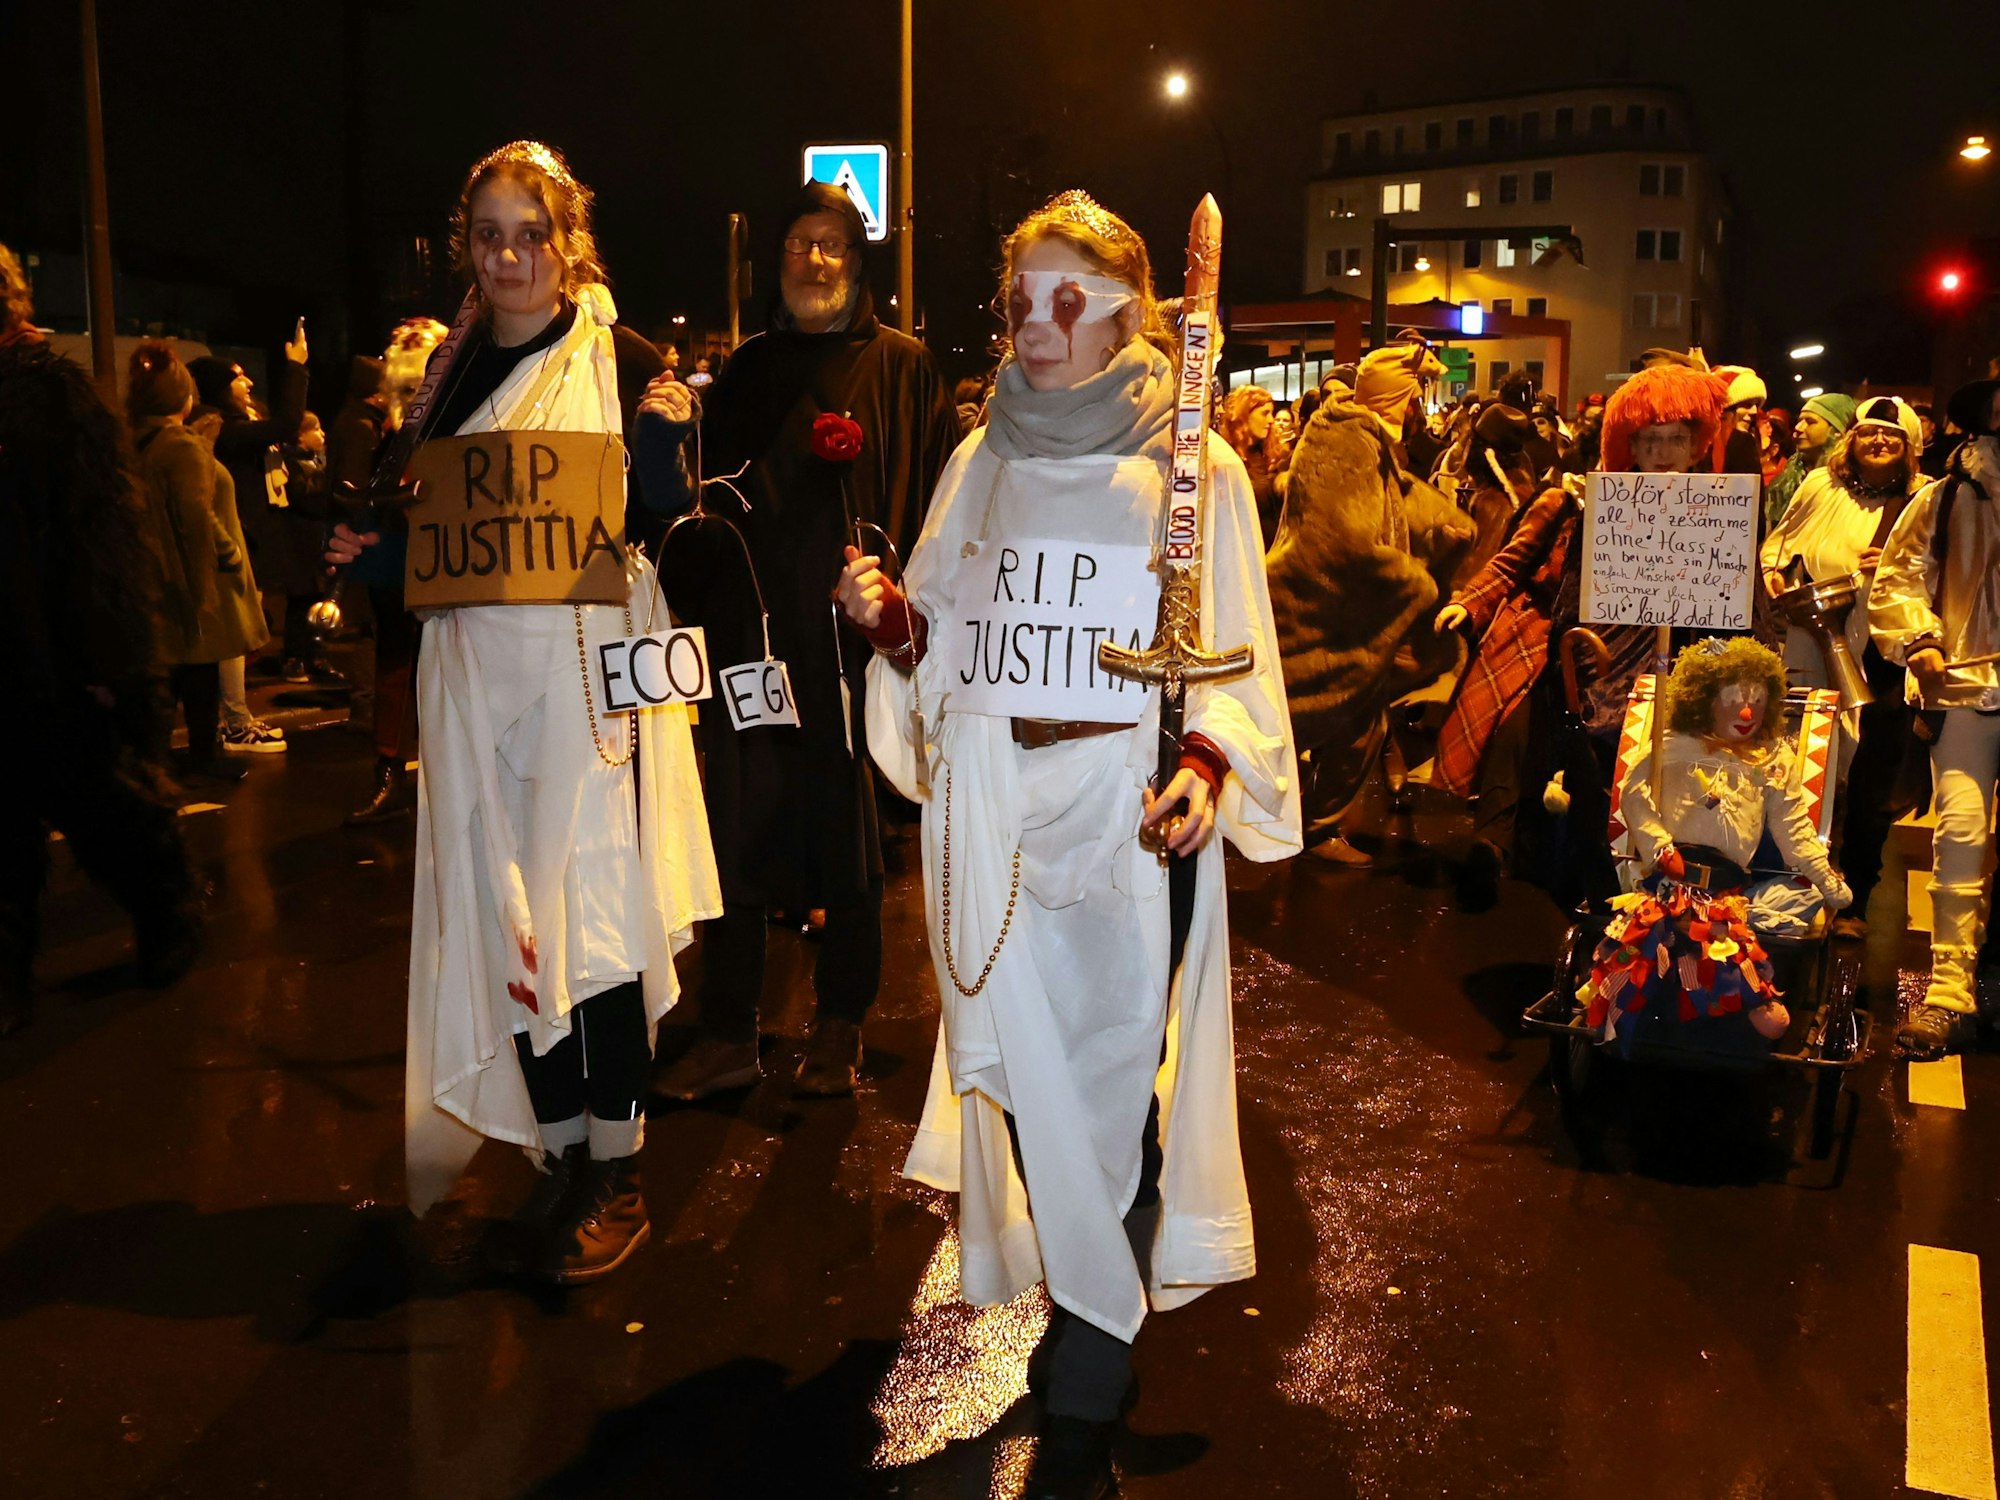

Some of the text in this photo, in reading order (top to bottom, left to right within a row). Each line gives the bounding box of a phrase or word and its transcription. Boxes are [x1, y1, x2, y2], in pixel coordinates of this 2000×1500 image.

[404, 368, 443, 420] BLUT
[1455, 382, 1465, 395] P
[1166, 320, 1207, 560] BLOOD OF THE INNOCENT
[1674, 477, 1752, 507] stommer
[1598, 506, 1627, 525] all
[1637, 508, 1656, 525] he
[414, 512, 624, 582] JUSTITIA
[1595, 525, 1706, 554] ohne Hass
[1593, 565, 1631, 581] einfach
[1691, 572, 1722, 587] all
[1594, 547, 1748, 576] un bei uns sin Minsche
[993, 548, 1097, 608] R.I.P.
[1602, 582, 1661, 597] simmer
[1683, 604, 1714, 627] dat
[1721, 604, 1746, 628] he
[599, 632, 704, 710] ECO
